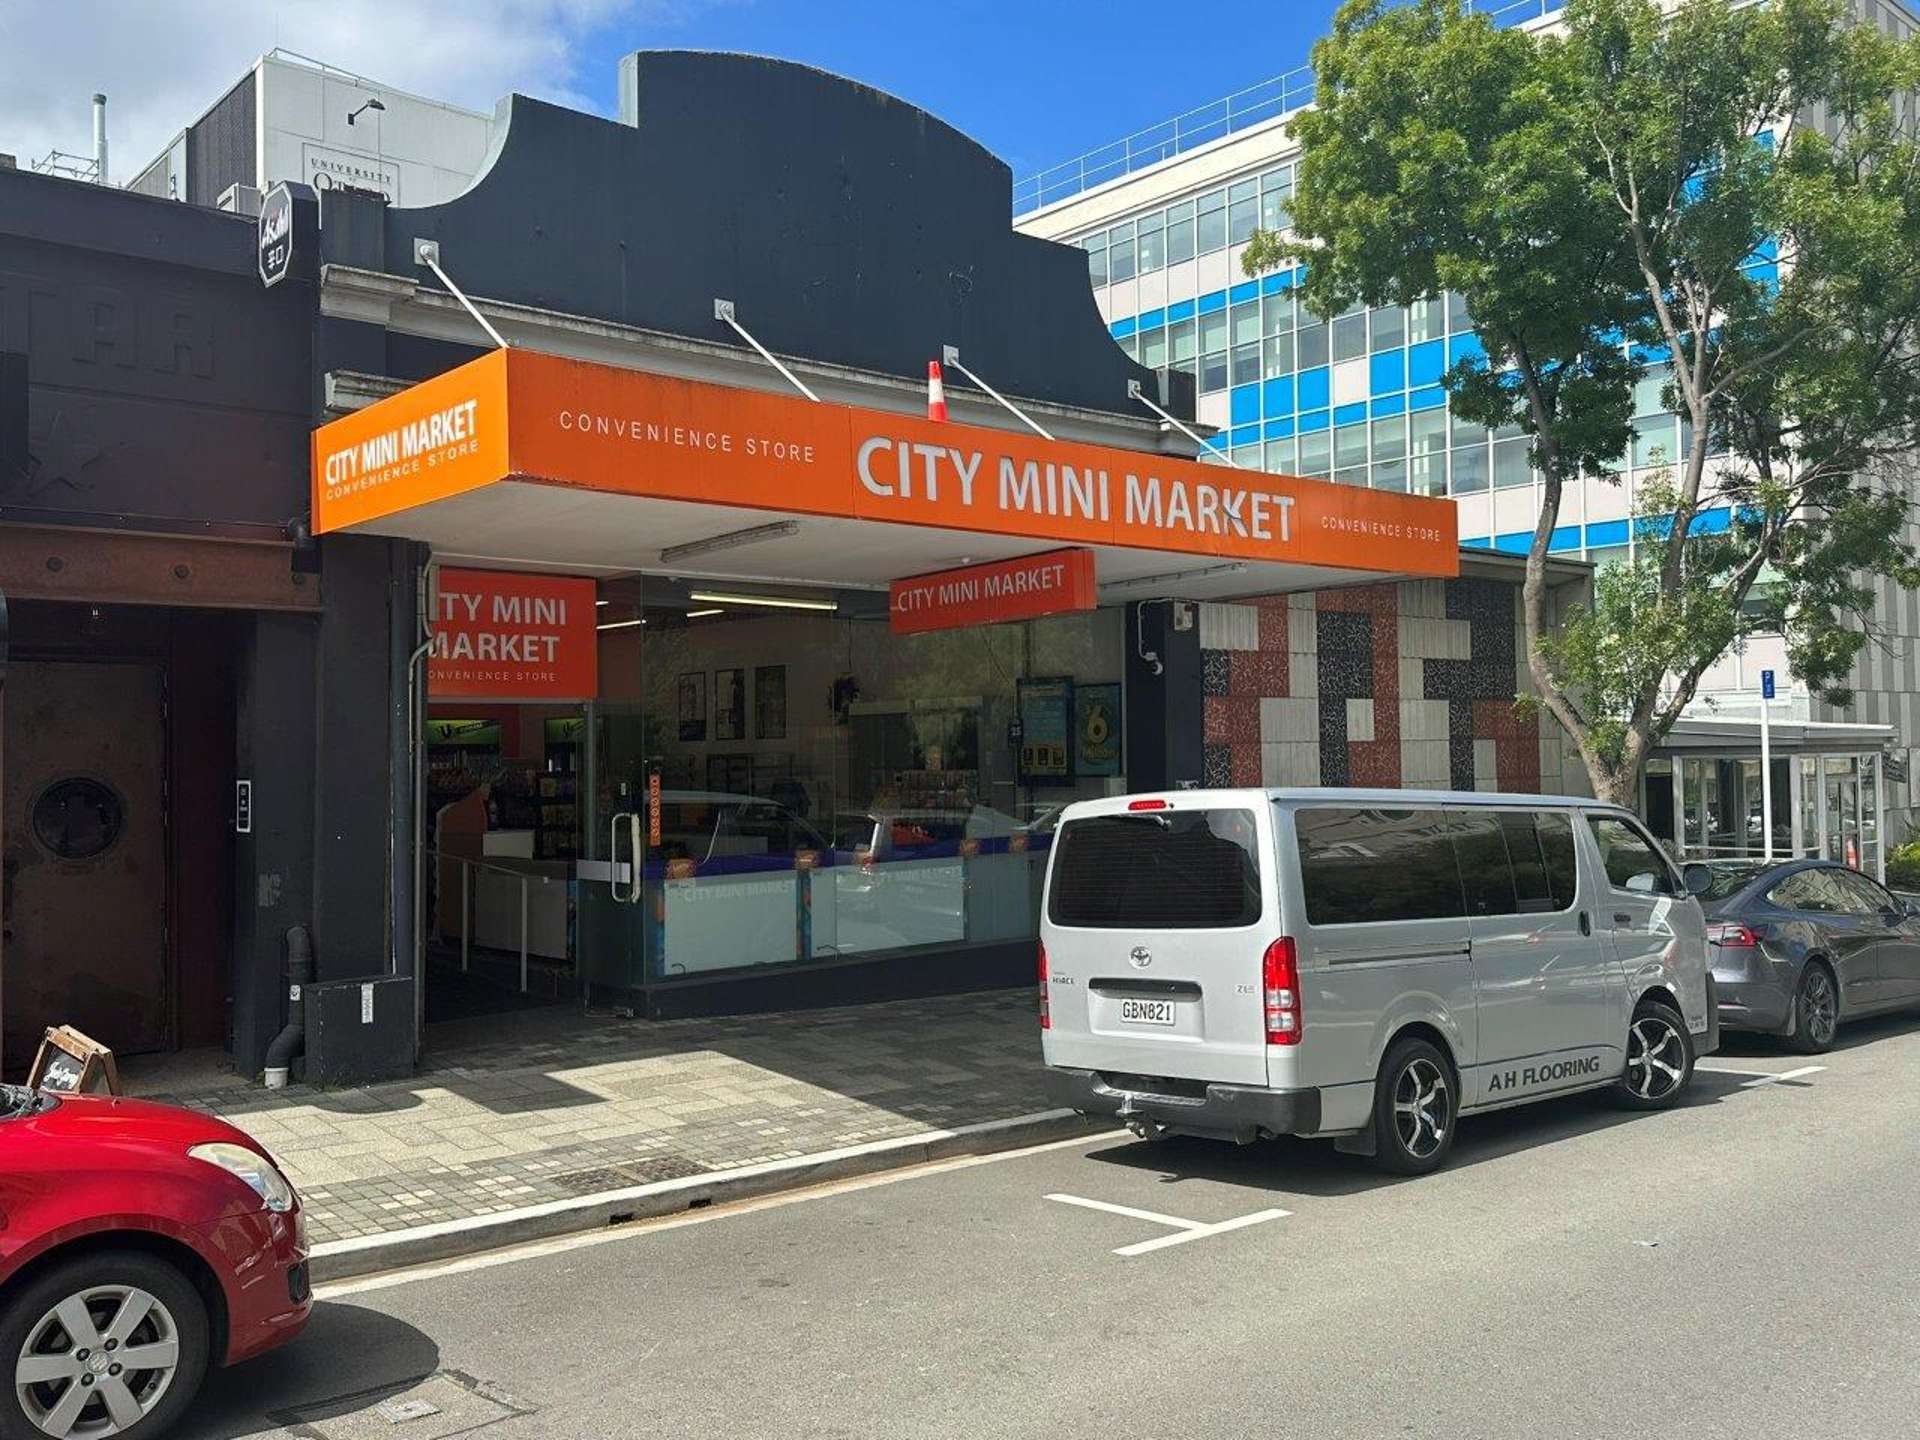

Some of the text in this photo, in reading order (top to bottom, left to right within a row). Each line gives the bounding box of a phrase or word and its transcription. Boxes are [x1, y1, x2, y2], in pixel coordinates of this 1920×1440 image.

[311, 158, 391, 184] UNIVERSITY
[326, 399, 478, 486] CITY MINI MARKET
[560, 410, 815, 464] CONVENIENCE STORE
[326, 438, 480, 501] CONVENIENCE STORE
[856, 436, 1296, 542] CITY MINI MARKET
[1320, 515, 1441, 542] CONVENIENCE STORE
[897, 564, 1065, 613] CITY MINI MARKET
[492, 594, 567, 625] MINI
[427, 630, 561, 663] MARKET
[428, 669, 556, 683] ONVENIENCE STORE
[1122, 1001, 1171, 1022] GBN821
[1522, 1055, 1600, 1086] FLOORING
